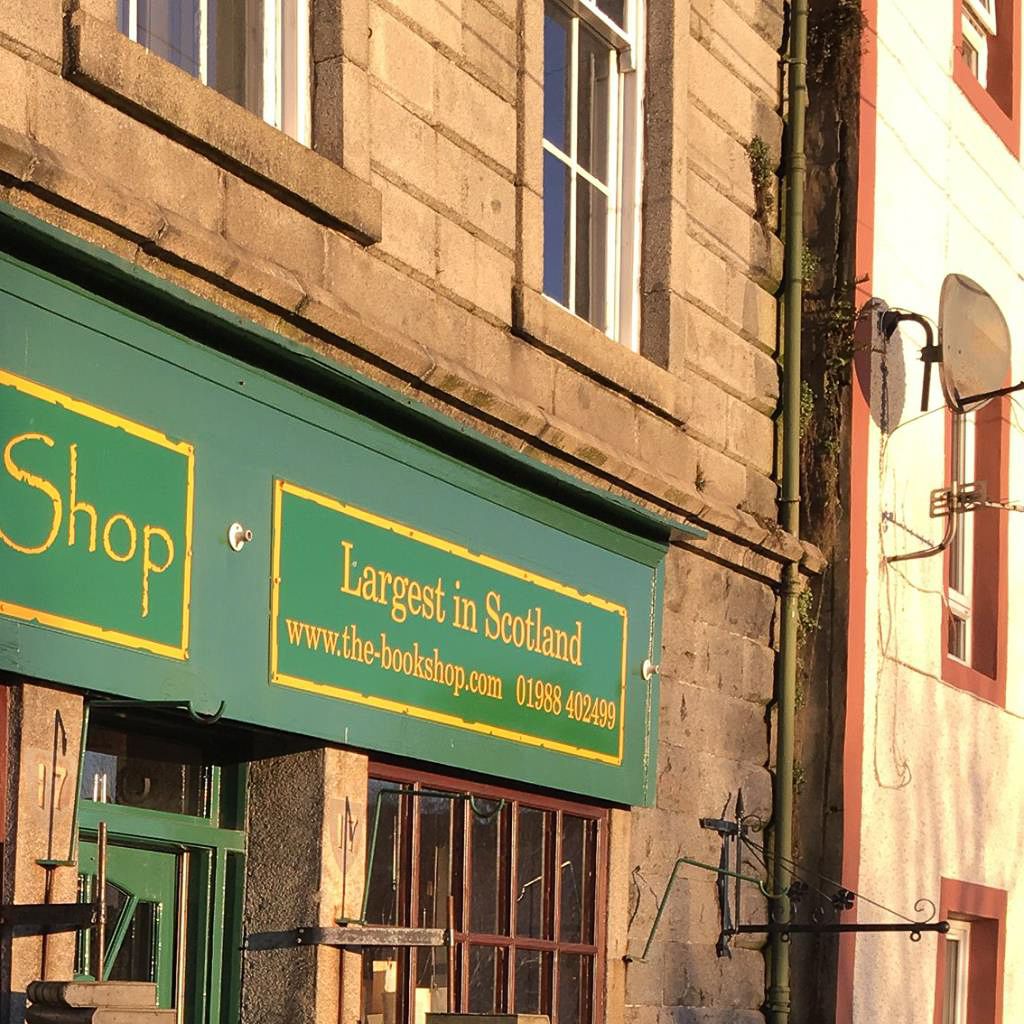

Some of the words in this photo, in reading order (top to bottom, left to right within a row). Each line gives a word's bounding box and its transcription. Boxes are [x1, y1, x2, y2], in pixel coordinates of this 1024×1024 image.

[339, 540, 447, 624] Largest
[452, 579, 479, 634] in
[484, 590, 583, 667] Scotland
[284, 617, 504, 700] www.the-bookshop.com
[515, 674, 563, 717] 01988
[565, 690, 617, 731] 402499
